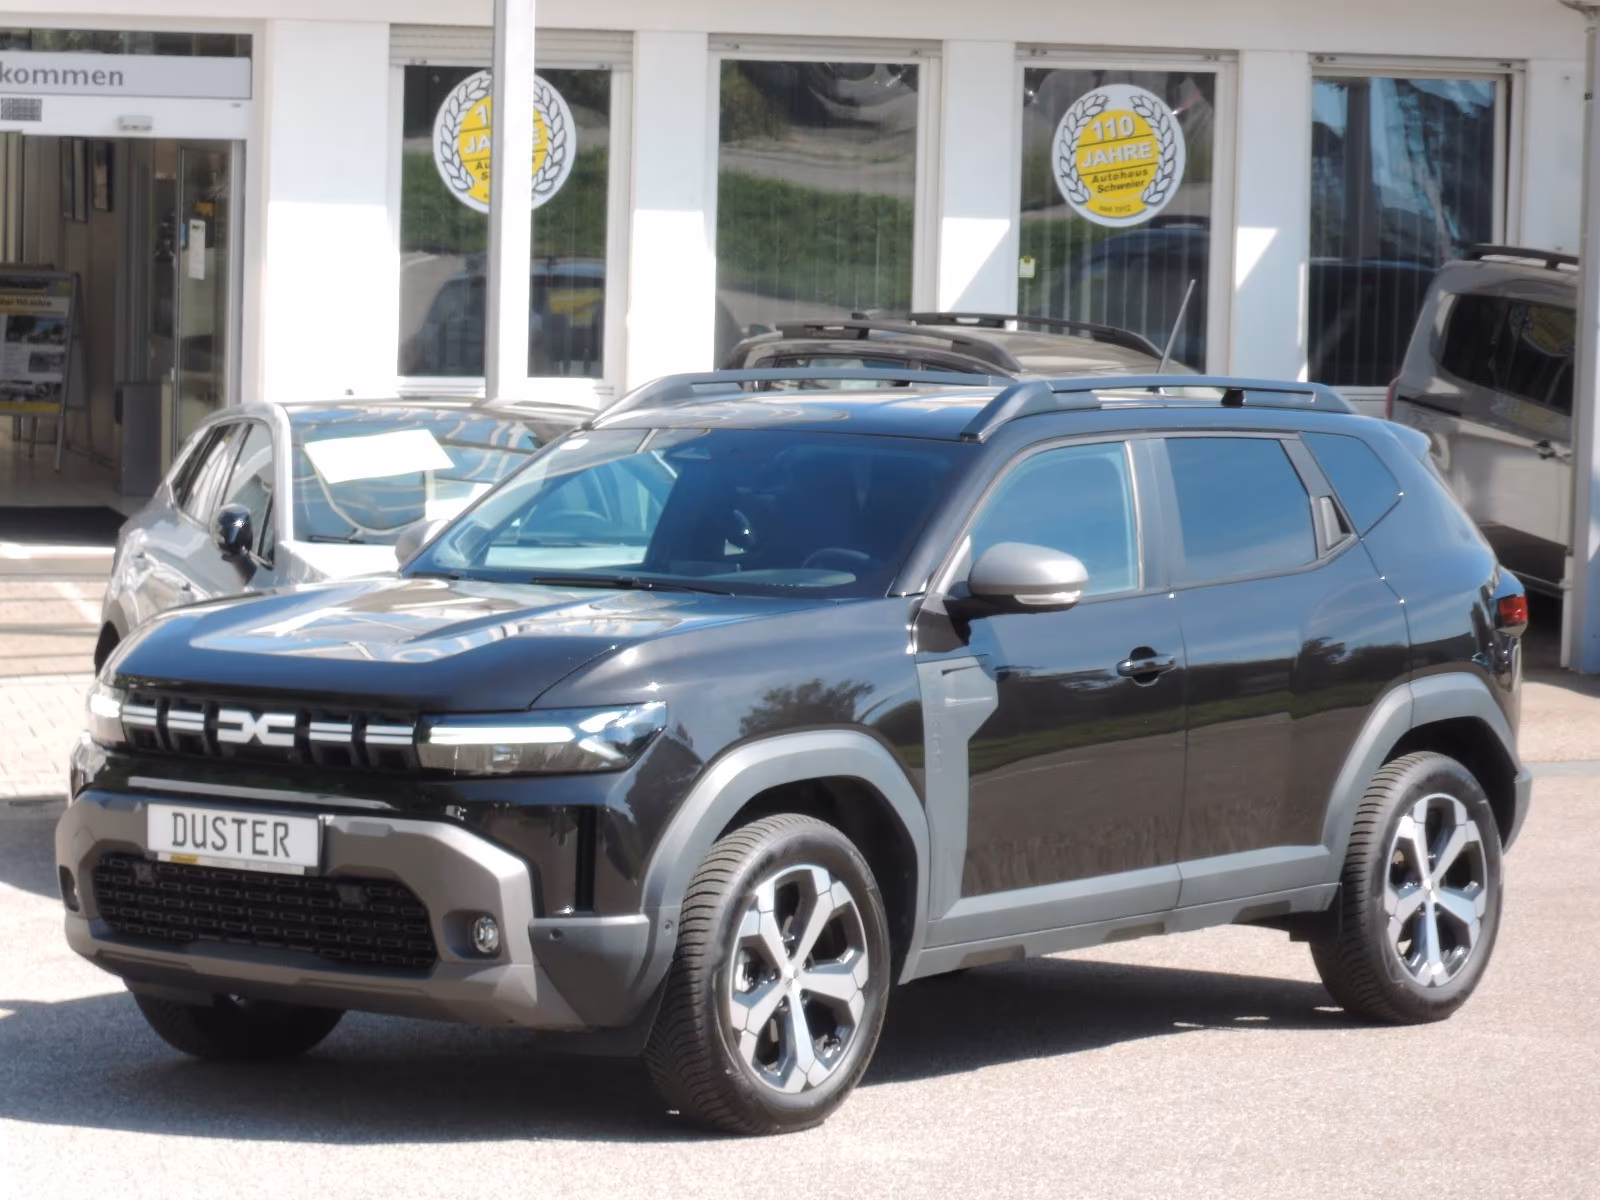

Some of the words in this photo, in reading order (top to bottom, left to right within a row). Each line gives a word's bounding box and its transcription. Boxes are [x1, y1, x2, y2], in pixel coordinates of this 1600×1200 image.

[464, 126, 542, 155] JAE
[1092, 115, 1135, 143] 110
[1082, 142, 1153, 168] JAHRE
[1092, 168, 1149, 184] Autohaus
[1097, 180, 1145, 194] Schweier
[172, 811, 290, 858] DUSTER
